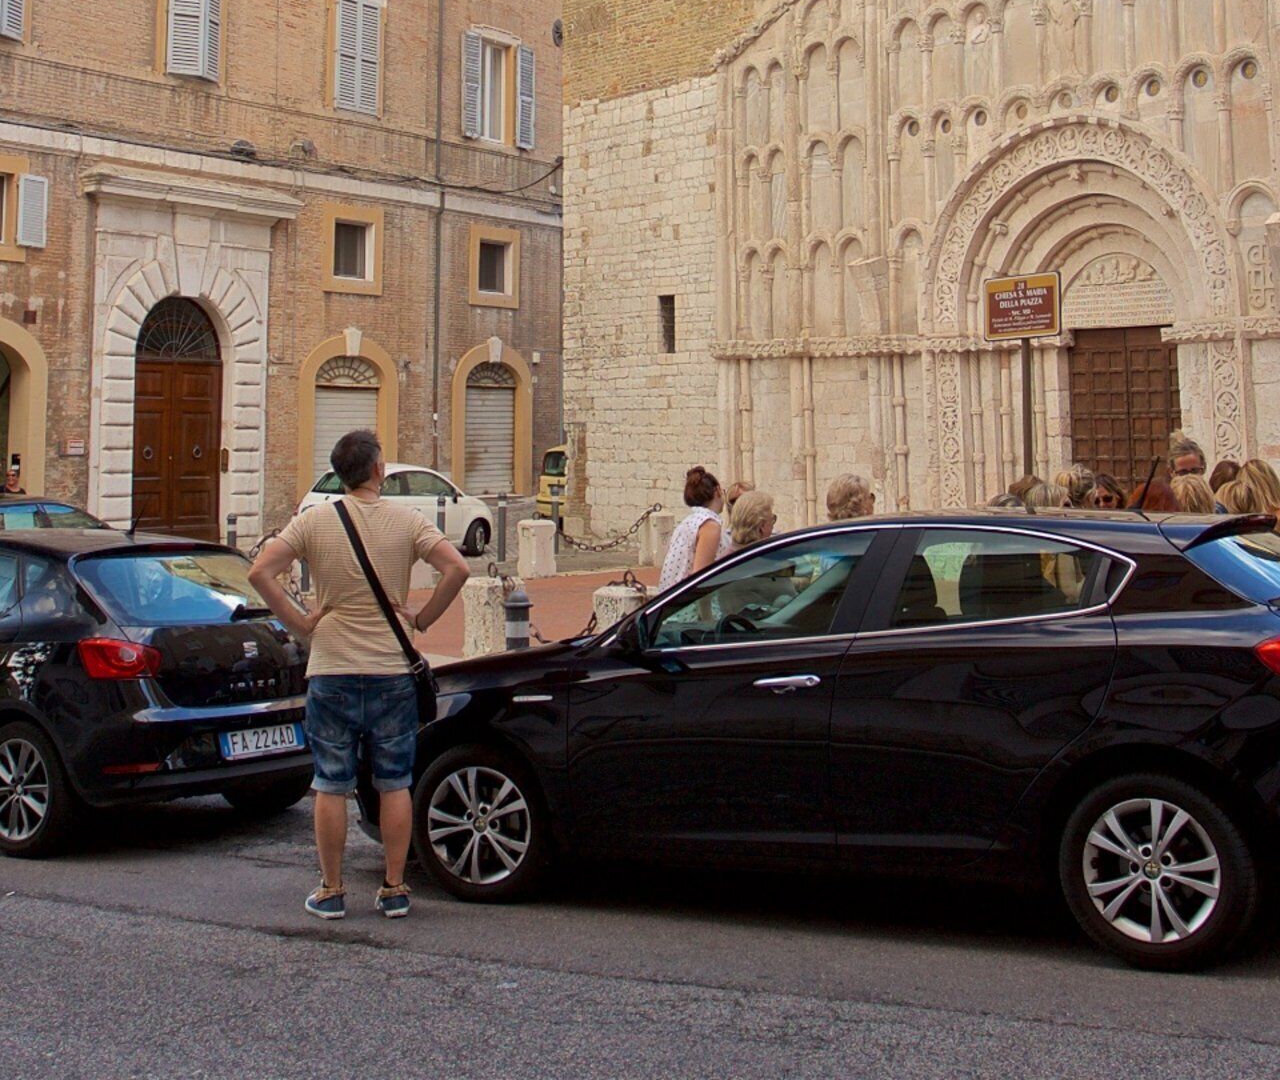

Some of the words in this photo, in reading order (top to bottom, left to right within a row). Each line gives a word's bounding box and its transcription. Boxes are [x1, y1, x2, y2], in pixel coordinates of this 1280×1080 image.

[995, 291, 1017, 300] CHIESA
[1018, 290, 1024, 298] S.
[1026, 288, 1047, 297] MARIA
[1000, 300, 1019, 309] DELLA
[1020, 297, 1043, 306] PIAZZA
[230, 732, 250, 753] FA
[253, 726, 295, 750] 224AD
